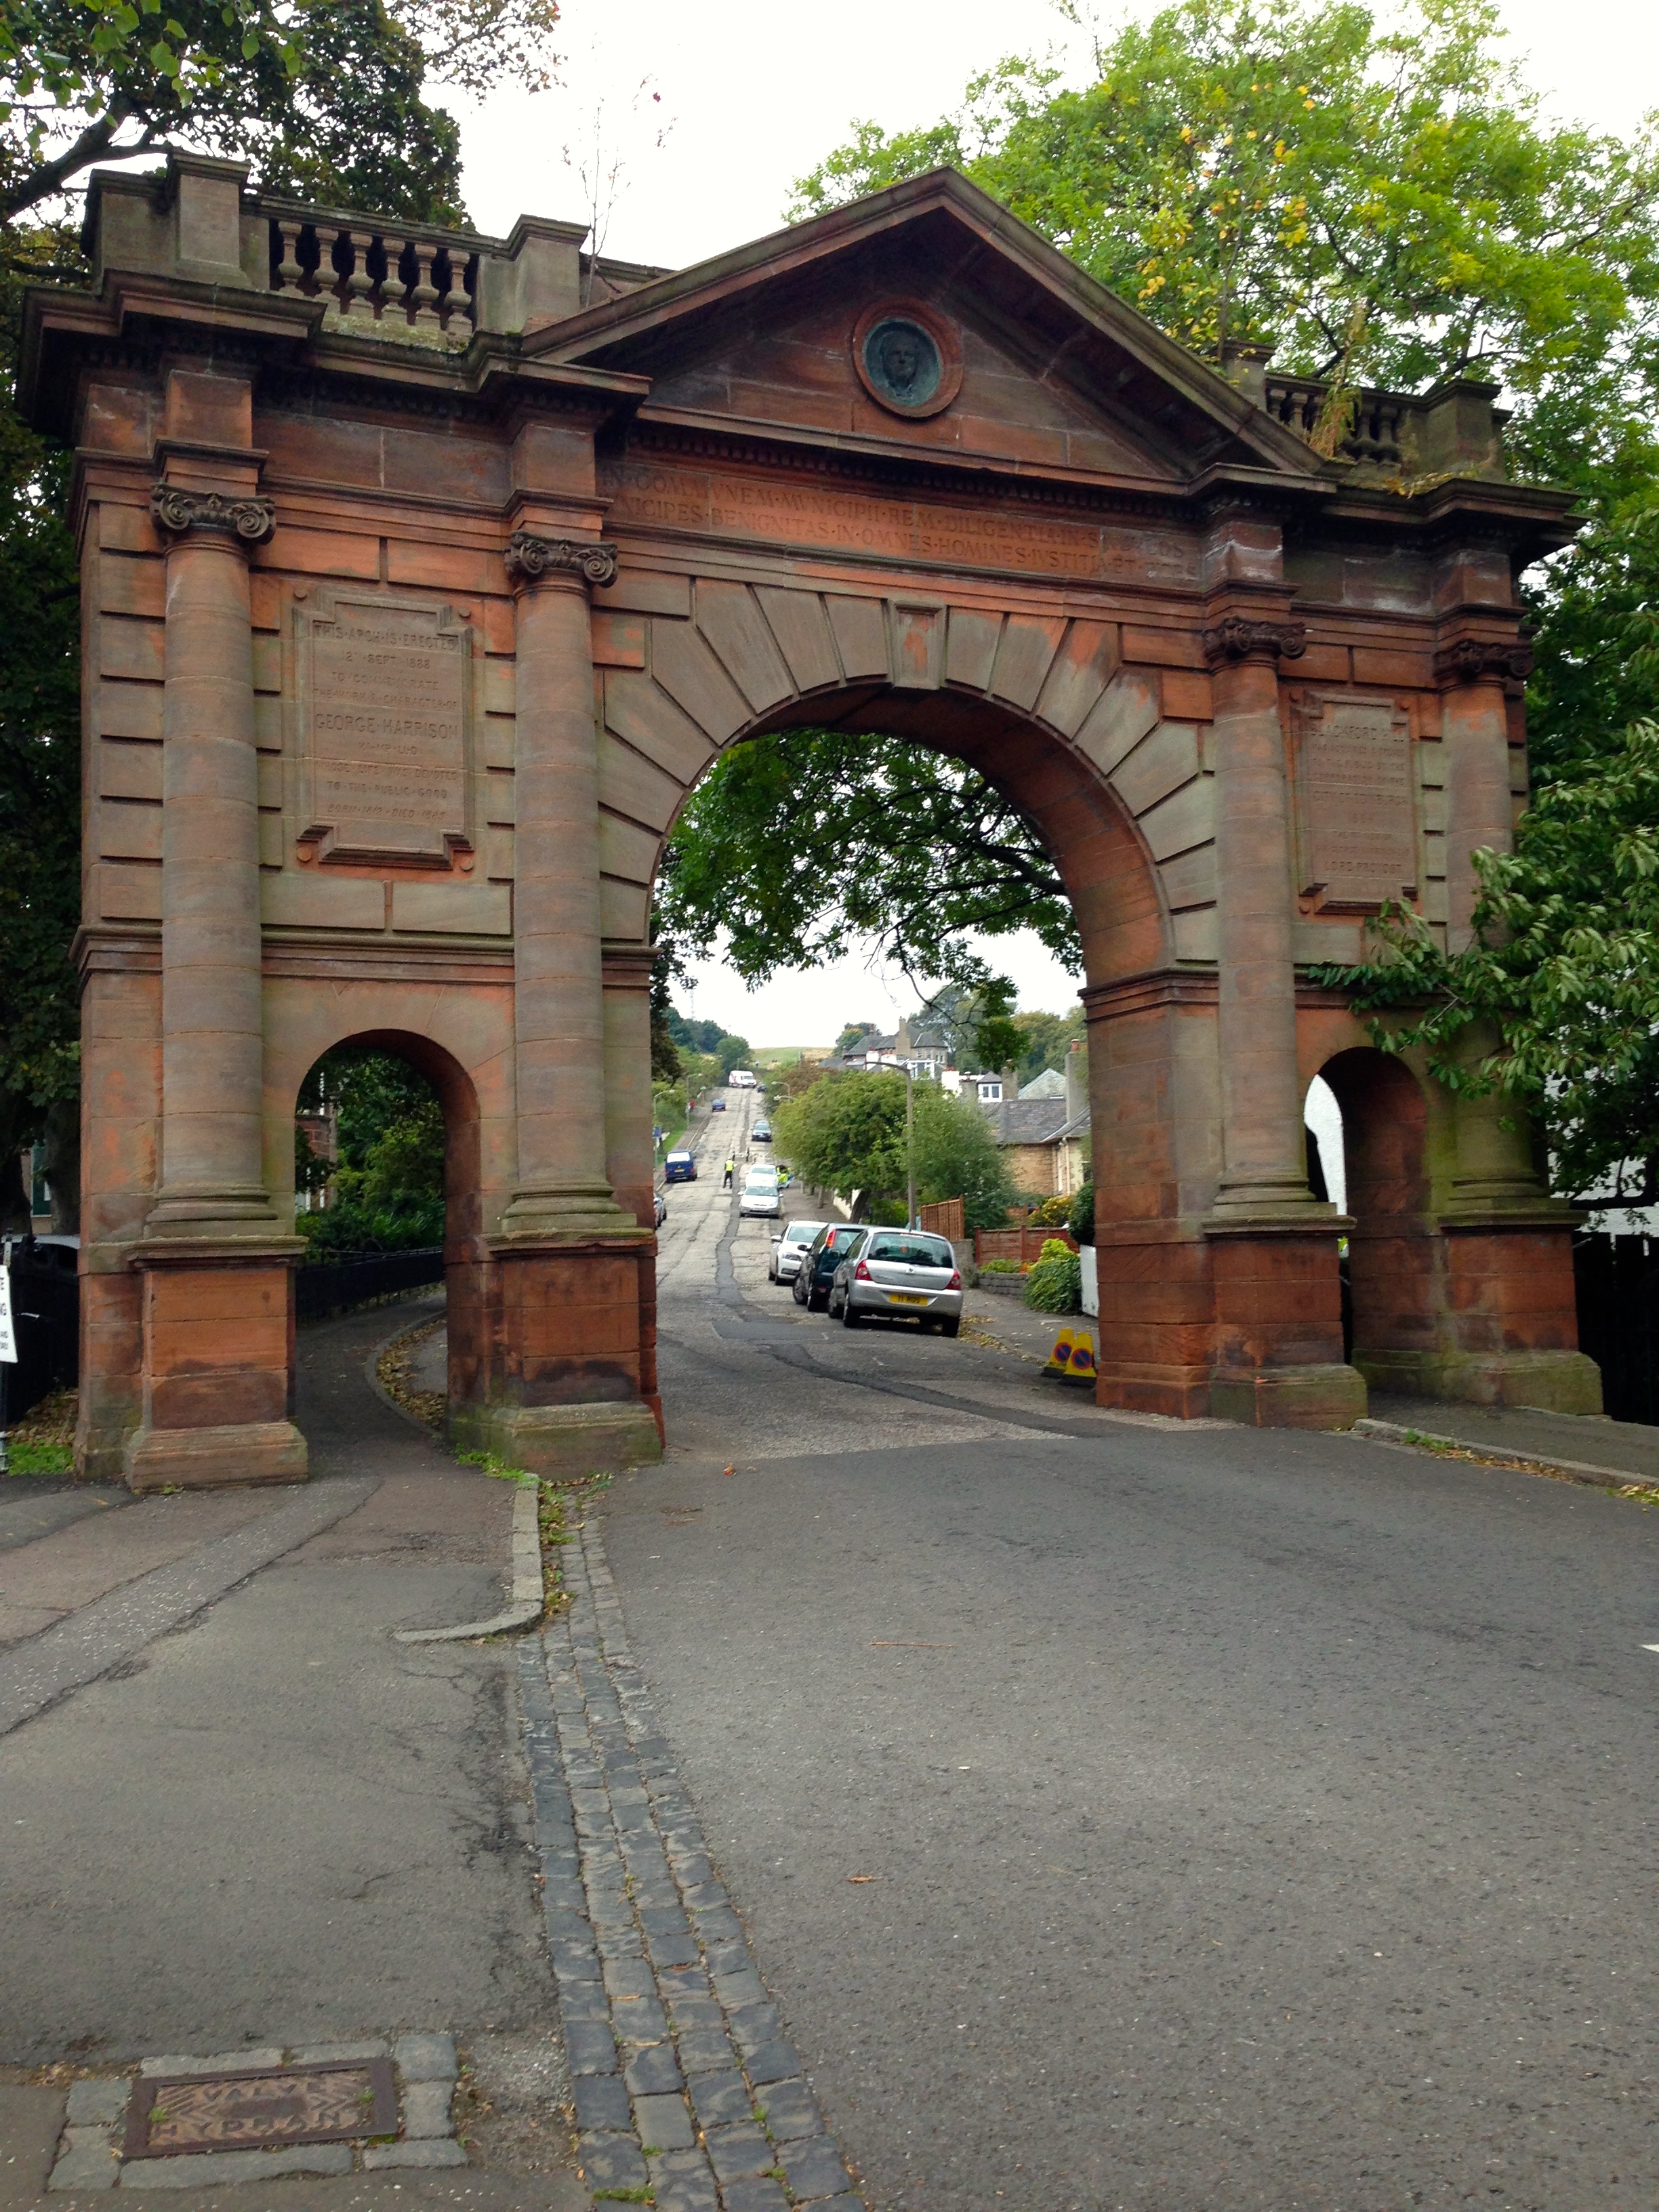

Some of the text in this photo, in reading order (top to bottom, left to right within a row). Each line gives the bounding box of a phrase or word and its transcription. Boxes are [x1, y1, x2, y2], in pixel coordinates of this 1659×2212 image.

[888, 506, 938, 531] REM
[711, 508, 830, 539] BENIGNITAS
[836, 525, 853, 542] IN
[861, 527, 932, 553] OMNES
[938, 537, 1027, 564] HOMINES
[313, 623, 344, 640] THIS
[315, 712, 458, 740] GEORGE HARRISON
[417, 787, 448, 800] GOOD
[203, 2080, 327, 2102] VALVE
